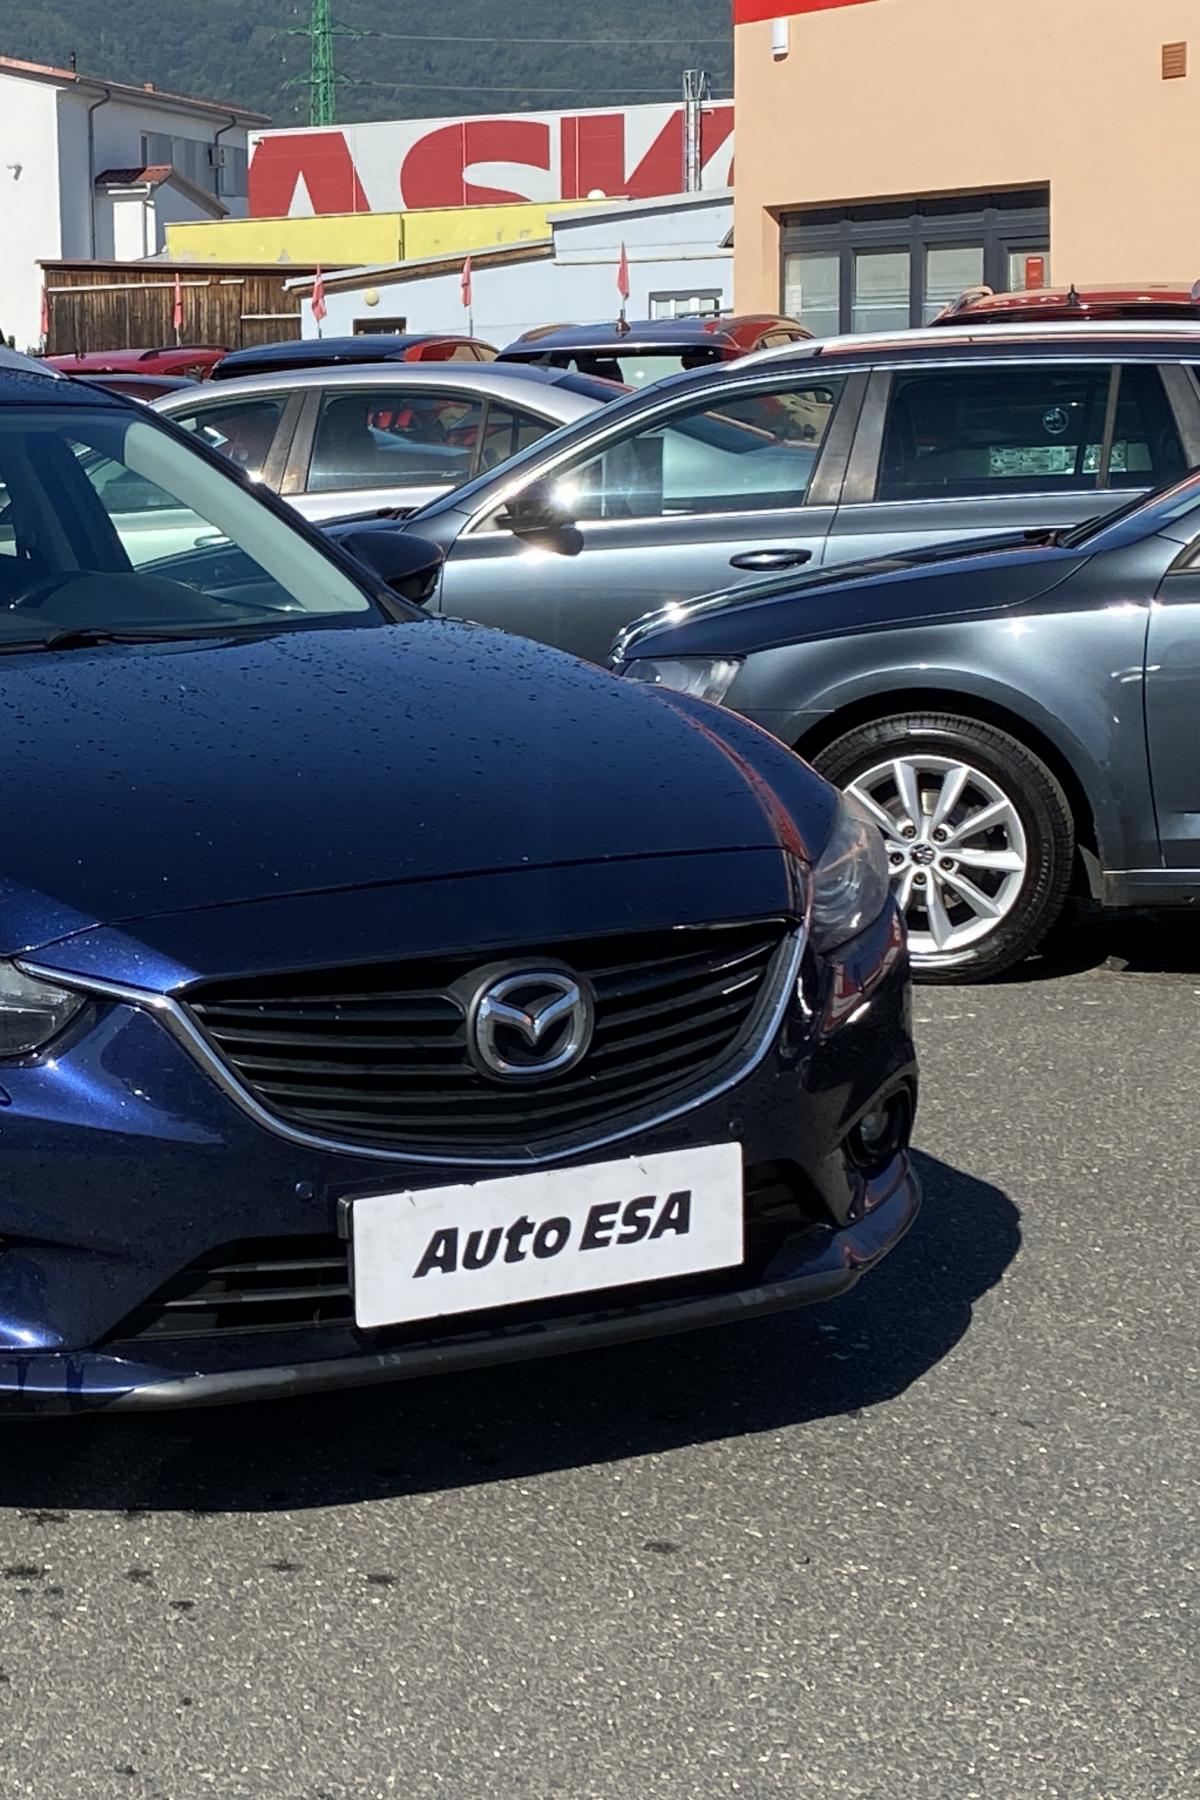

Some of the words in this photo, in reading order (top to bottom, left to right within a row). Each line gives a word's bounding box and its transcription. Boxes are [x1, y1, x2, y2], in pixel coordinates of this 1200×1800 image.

[248, 107, 734, 217] ASK
[412, 1216, 571, 1278] Auto
[578, 1190, 691, 1251] ESA
